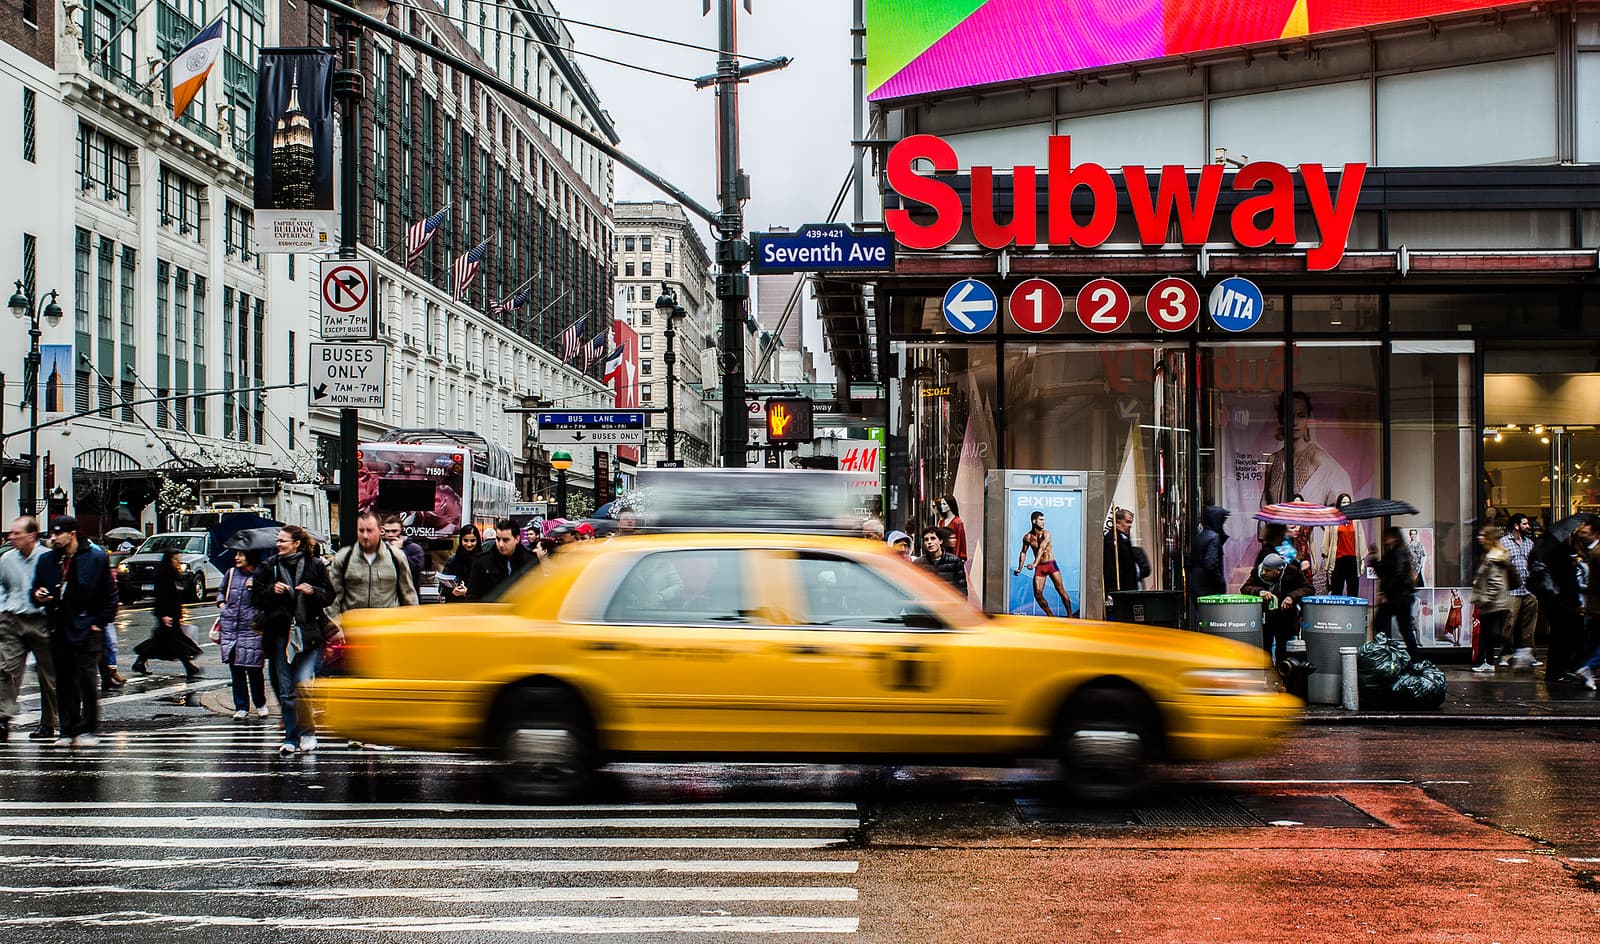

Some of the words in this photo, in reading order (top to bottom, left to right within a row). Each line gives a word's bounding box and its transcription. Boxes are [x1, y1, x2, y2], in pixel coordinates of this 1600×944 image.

[885, 134, 1368, 271] Subway
[806, 230, 821, 238] 439
[828, 230, 843, 238] 421
[764, 243, 842, 262] Seventh
[849, 242, 886, 261] Ave
[1026, 287, 1044, 324] 1
[1090, 287, 1118, 324] 2
[1159, 285, 1188, 323] 3
[1213, 284, 1254, 320] MTA
[322, 349, 373, 363] BUSES
[327, 365, 368, 379] ONLY
[331, 395, 349, 403] MON
[369, 395, 382, 404] FRI
[568, 415, 583, 423] BUS
[593, 415, 614, 423] LANE
[592, 432, 617, 440] BUSES
[620, 432, 639, 440] ONLY
[840, 447, 878, 472] H&M
[426, 467, 445, 476] 71501
[1235, 472, 1263, 481] $14.95
[1030, 475, 1063, 485] TITAN
[1017, 496, 1076, 508] 2(X)IST
